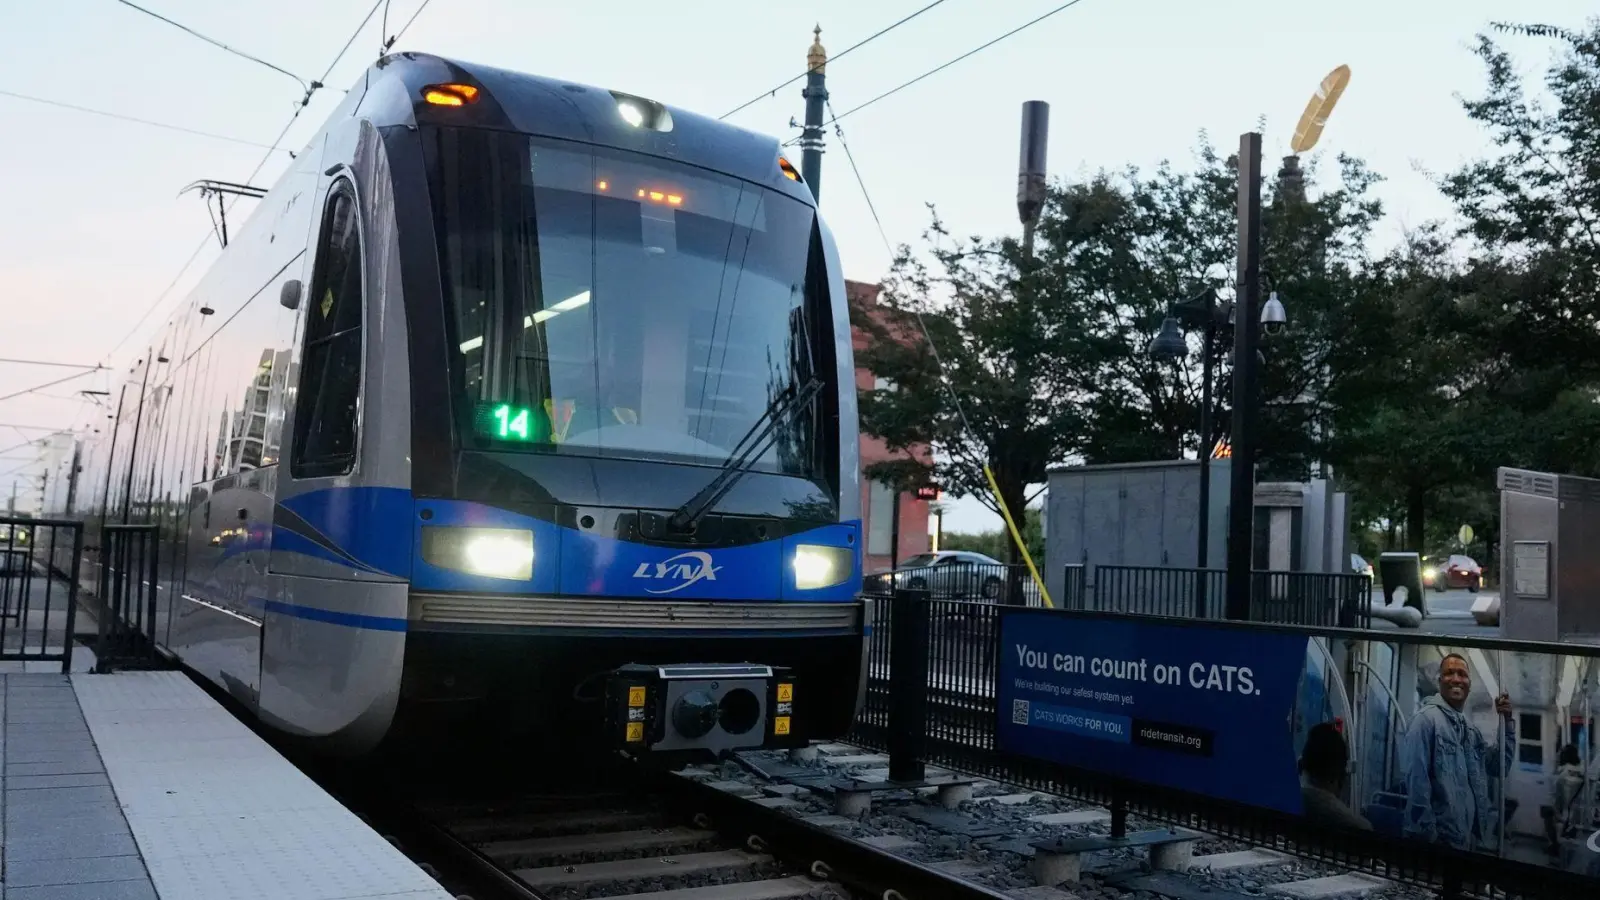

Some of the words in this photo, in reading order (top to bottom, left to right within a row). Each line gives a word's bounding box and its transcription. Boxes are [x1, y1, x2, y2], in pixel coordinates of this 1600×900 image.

[494, 404, 529, 438] 14
[632, 551, 724, 581] LYNX
[1016, 644, 1047, 669] You
[1053, 653, 1085, 674] can
[1091, 657, 1147, 682] count
[1153, 664, 1181, 686] on
[1189, 662, 1261, 696] CATS.
[1014, 678, 1033, 690] We're
[1034, 681, 1060, 696] building
[1060, 687, 1073, 696] our
[1073, 687, 1094, 699] safest
[1095, 690, 1120, 703] system
[1121, 695, 1135, 706] yet.
[1034, 709, 1054, 722] CATS
[1055, 713, 1086, 727] WORKS
[1085, 718, 1102, 731] FOR
[1103, 720, 1123, 735] YOU.
[1140, 727, 1201, 749] ridetransit.org
